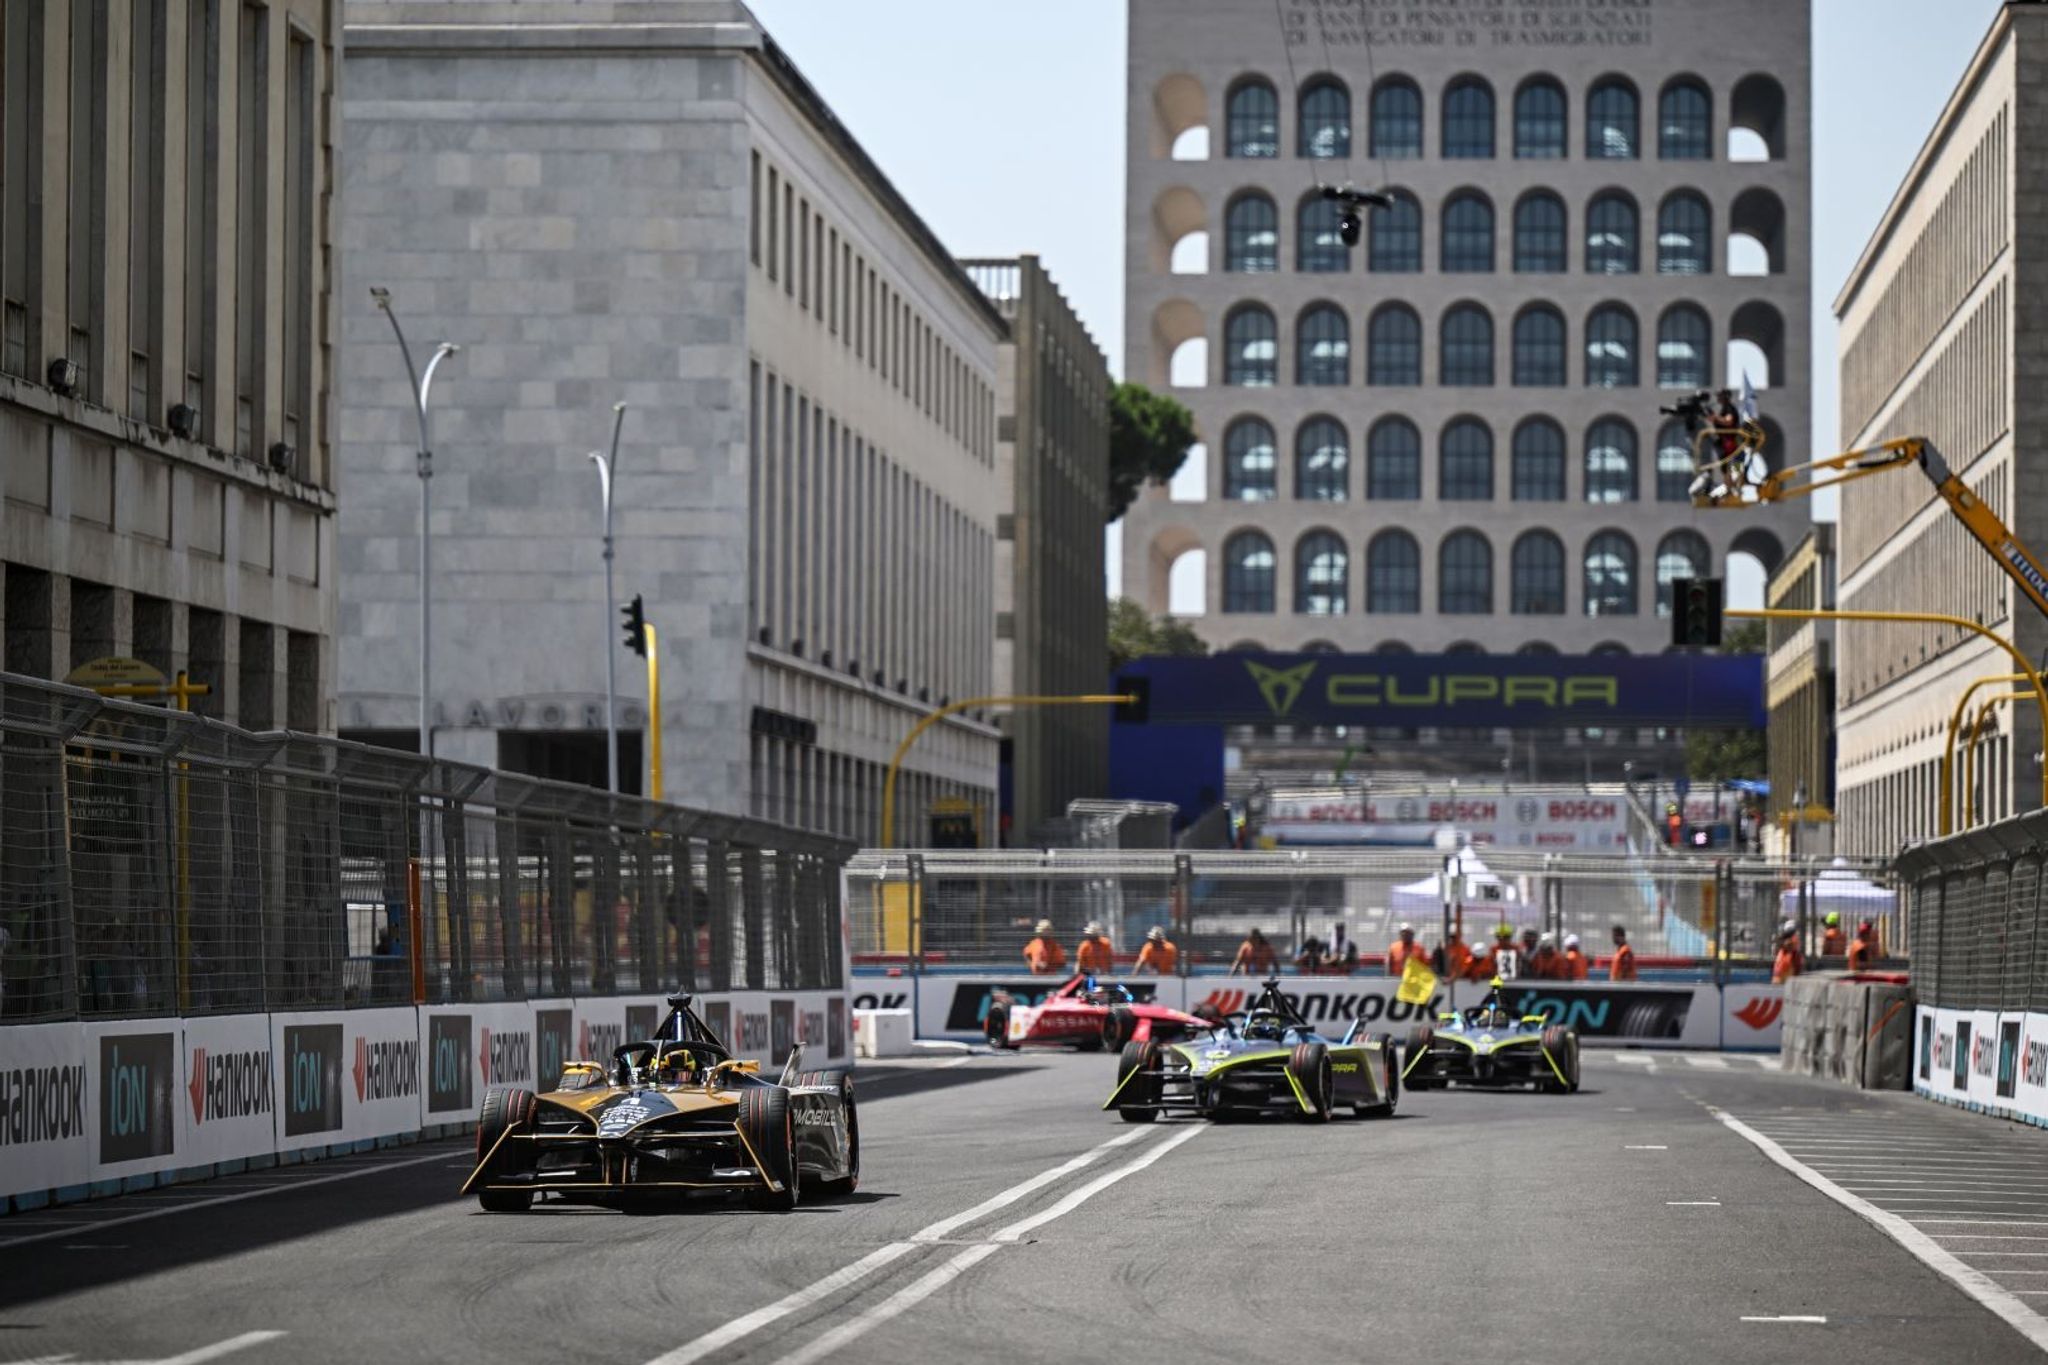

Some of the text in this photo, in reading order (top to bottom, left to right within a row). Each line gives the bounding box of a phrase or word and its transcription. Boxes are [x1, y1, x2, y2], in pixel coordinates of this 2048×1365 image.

[1327, 675, 1618, 707] CUPRA
[1429, 801, 1497, 821] BOSCH
[1548, 801, 1617, 820] BOSCH
